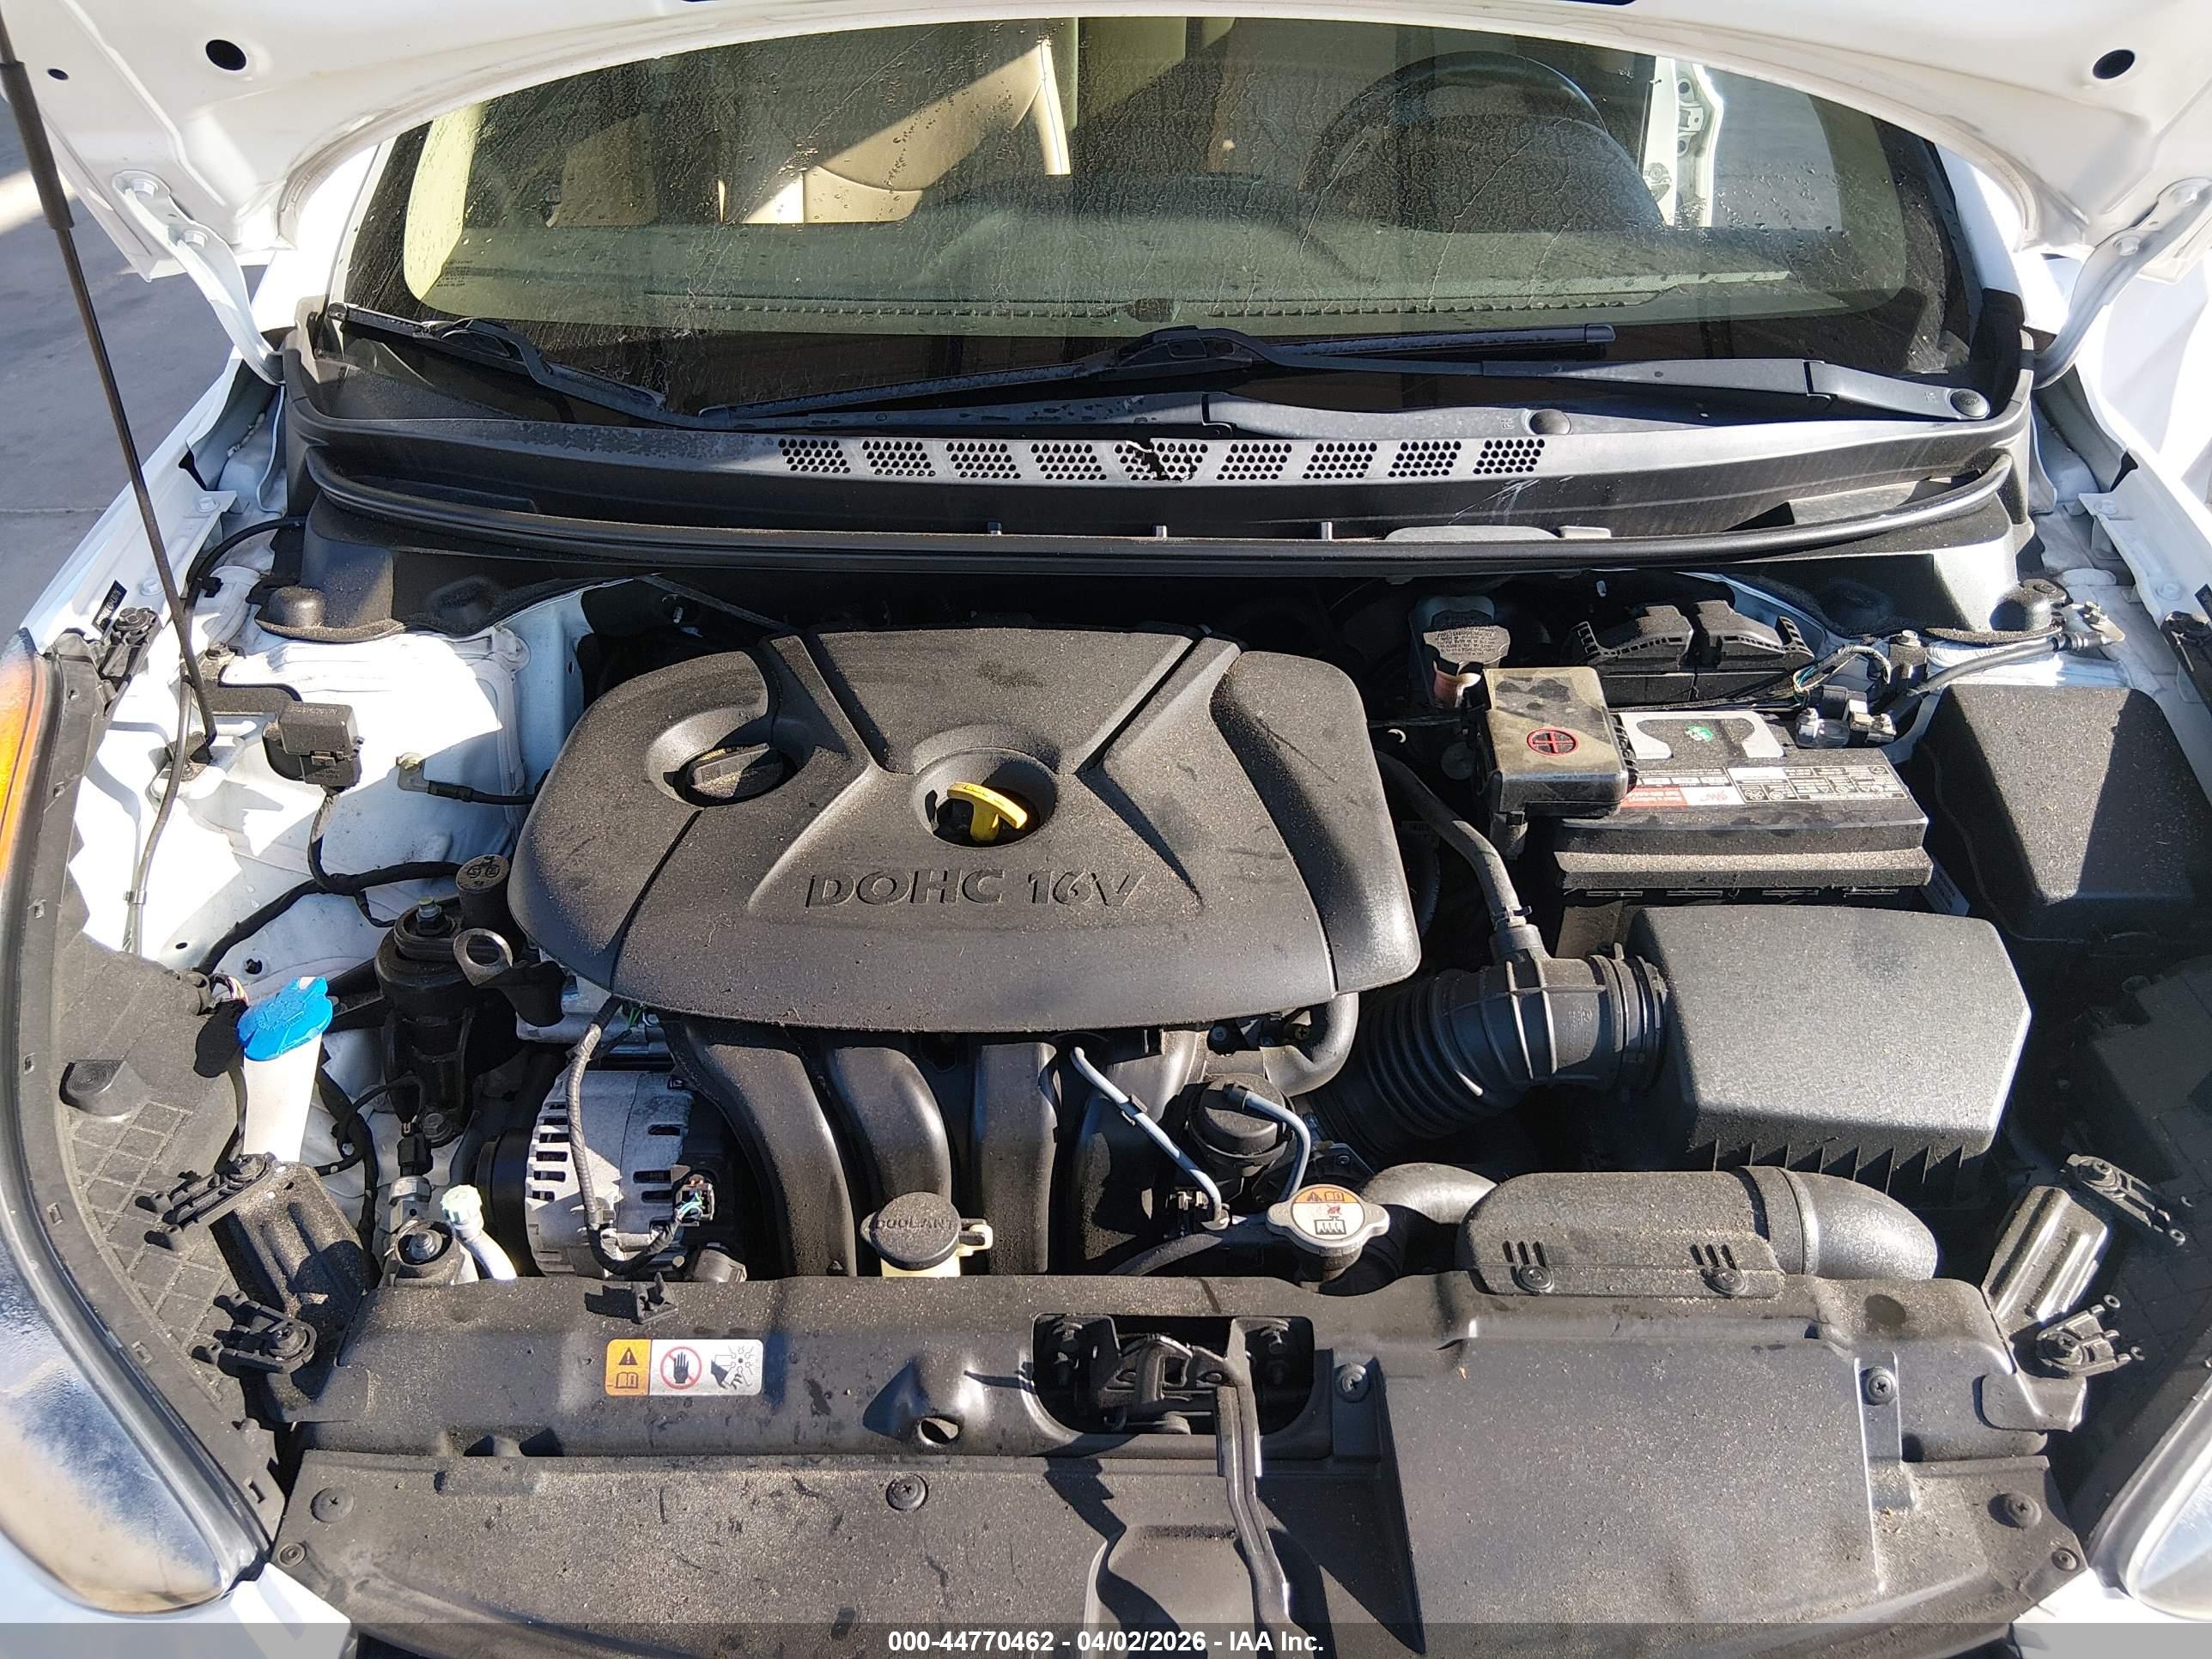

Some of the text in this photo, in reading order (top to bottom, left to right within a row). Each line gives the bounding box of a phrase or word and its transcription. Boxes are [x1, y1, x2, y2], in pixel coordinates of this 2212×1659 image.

[805, 870, 1146, 908] DOHC 16V
[874, 1214, 956, 1231] COOLANT
